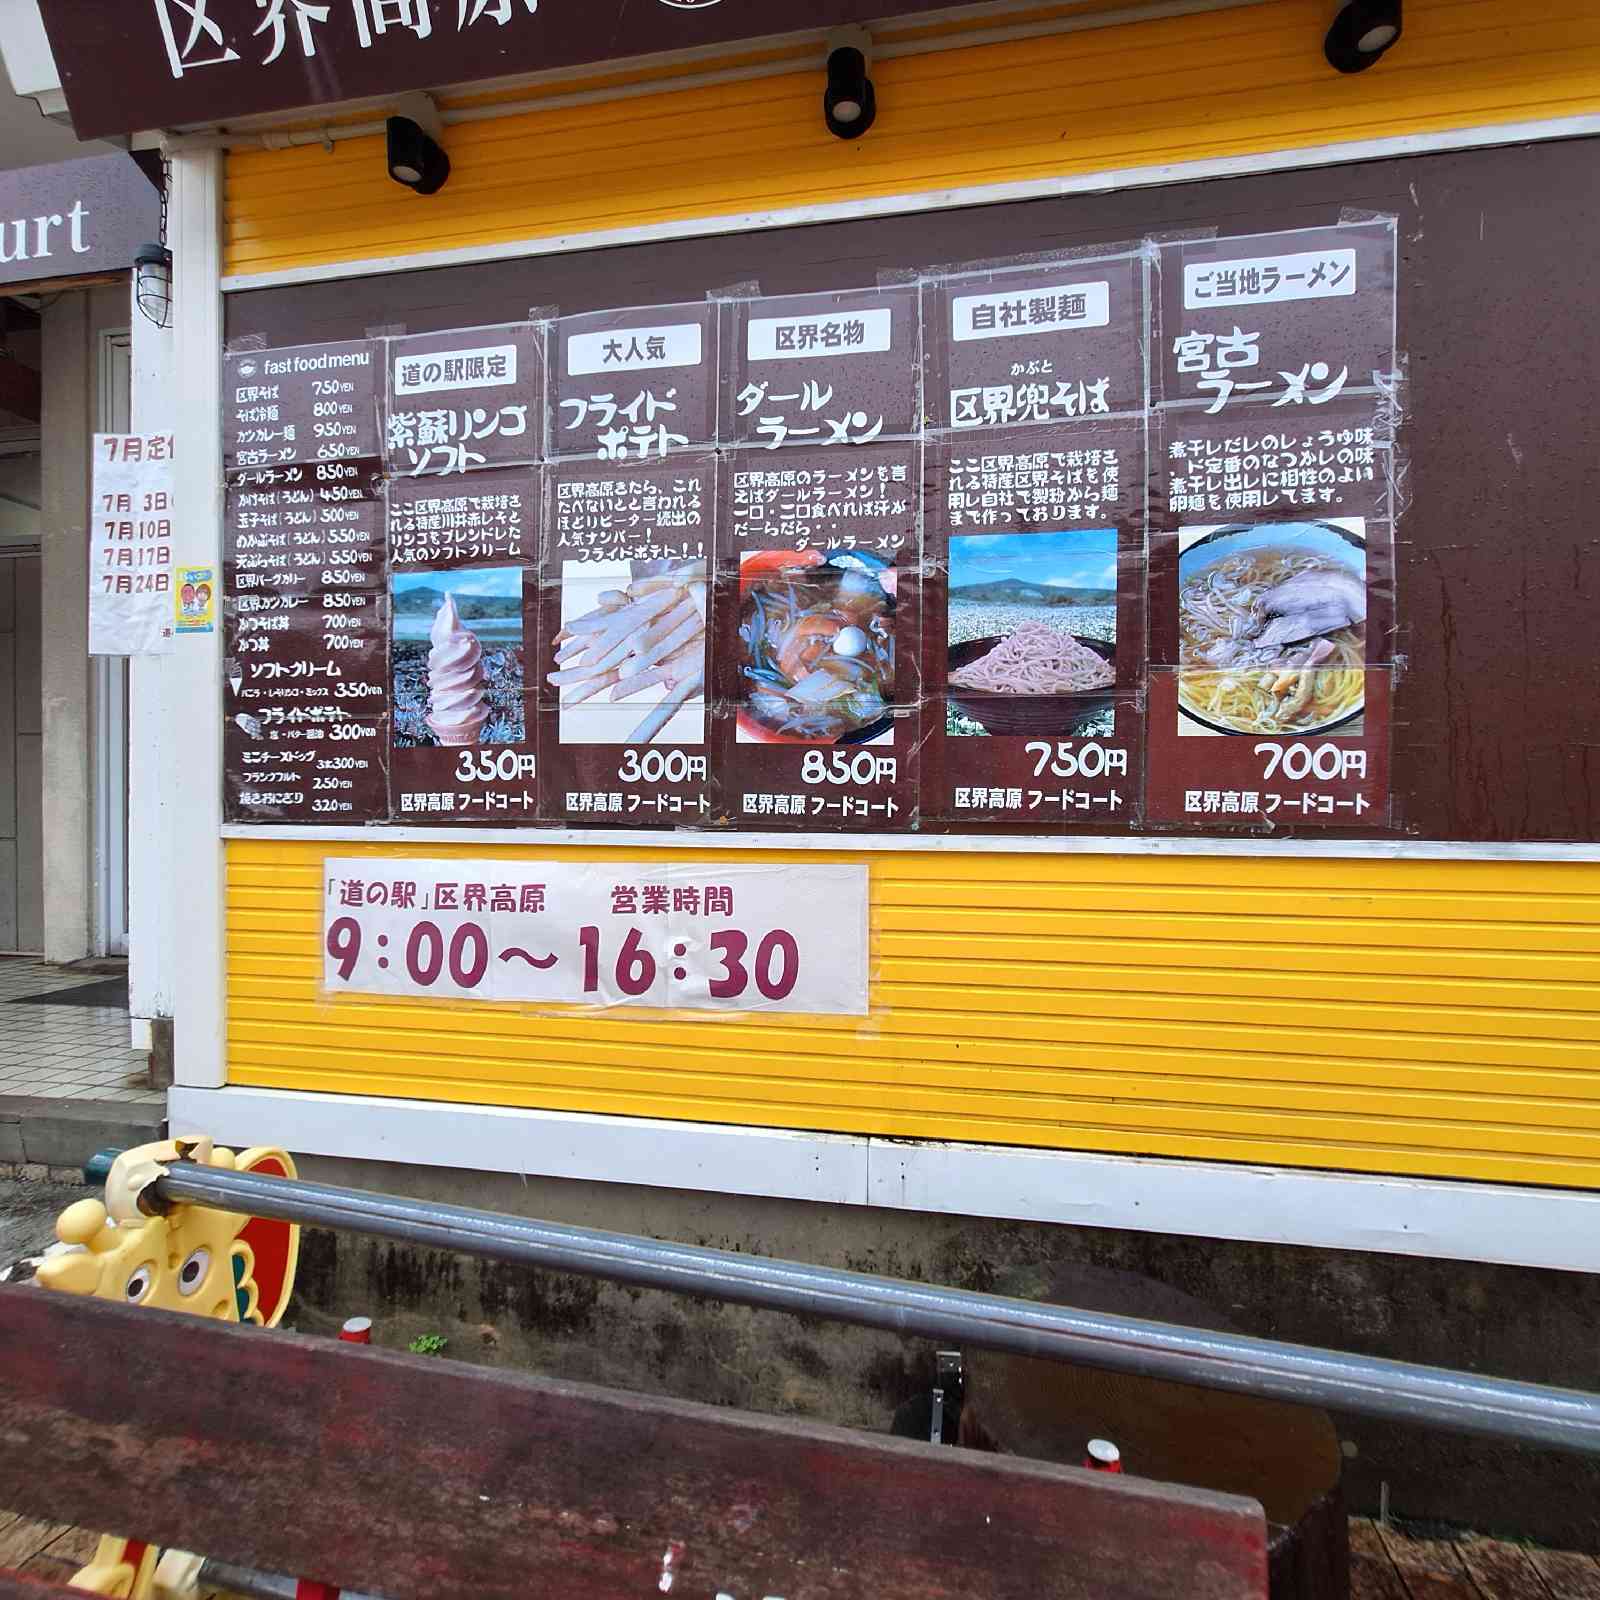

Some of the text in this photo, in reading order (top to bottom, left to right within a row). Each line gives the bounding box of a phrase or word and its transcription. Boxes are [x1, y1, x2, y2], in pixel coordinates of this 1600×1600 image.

[0, 200, 90, 263] urt
[1194, 261, 1350, 298] ご当地ラーメン
[972, 293, 1086, 330] 自社製麺
[776, 320, 864, 350] 区界名物
[602, 336, 666, 364] 大人気
[1173, 326, 1260, 372] 宮古
[264, 359, 291, 374] fast
[401, 354, 506, 387] 道の駅限定
[1010, 359, 1053, 376] かぶと
[236, 384, 279, 403] 区界そば
[736, 380, 833, 416] ダール
[1197, 362, 1348, 414] ラーメン
[560, 388, 677, 430] フライド
[950, 376, 1110, 428] 区界兜そば
[388, 405, 528, 450] 紫蘇リンゴ
[756, 412, 883, 450] ラーメン
[104, 436, 174, 462] 7月定
[597, 424, 689, 460] ポテト
[408, 442, 486, 478] ソフト
[949, 450, 1118, 474] ここ区界高原で栽培さ
[734, 465, 907, 488] 区界高原のラーメンを言
[949, 466, 1118, 491] れる特産区界そばを使
[102, 494, 131, 512] 7月
[949, 504, 1107, 526] まで作っております。
[104, 519, 170, 540] 7月10日
[796, 534, 905, 552] ダールラーメン
[104, 546, 170, 566] 7月17日
[390, 542, 520, 564] 人気のソフトクリーム
[102, 574, 168, 594] 7月24日
[250, 660, 342, 679] ソフトクリーム
[258, 706, 352, 724] フライドポテト
[455, 749, 536, 782] 350円
[618, 749, 706, 782] 300円
[801, 750, 897, 785] 850円
[1025, 742, 1128, 778] 750円
[1254, 742, 1367, 780] 700円
[400, 790, 534, 812] 区界高原 フードコート
[566, 792, 710, 813] 区界高原 フードコート
[743, 794, 899, 818] 区界高原 フードコート
[954, 788, 1123, 810] 区界高原 フードコート
[1184, 790, 1370, 814] 区界高原 フードコート
[610, 886, 734, 916] 営業時間
